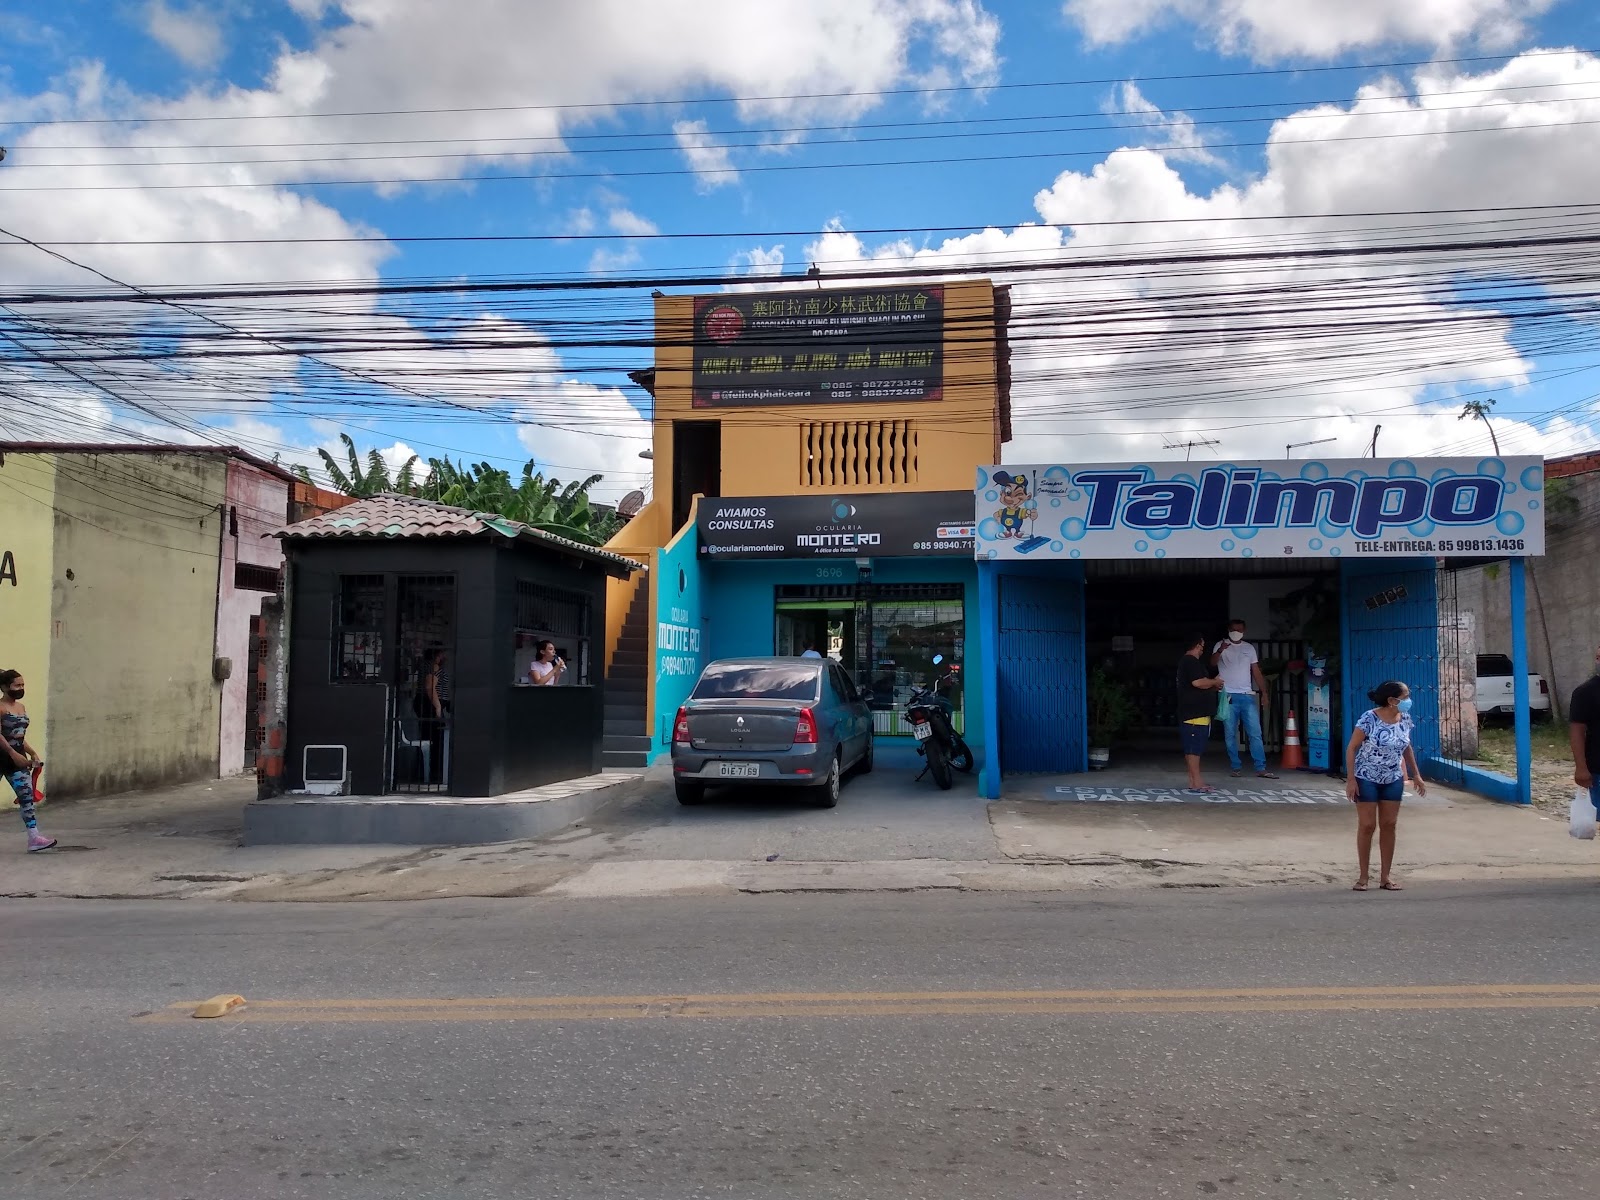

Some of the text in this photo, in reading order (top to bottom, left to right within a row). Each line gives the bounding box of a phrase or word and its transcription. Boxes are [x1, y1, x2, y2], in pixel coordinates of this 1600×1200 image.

[1073, 467, 1506, 540] Talimpo
[716, 507, 767, 518] AVIAMOS
[708, 520, 775, 530] CONSULTAS
[797, 533, 881, 546] MONTEIRO
[1355, 538, 1525, 552] TELE-ENTREGA: 85 99813.1436
[708, 544, 785, 554] @oculariamonteiro
[921, 541, 932, 550] 85
[816, 567, 843, 578] 3696
[1055, 785, 1412, 798] ESTACIONAMEN
[1077, 793, 1352, 804] PARA CLIENT
